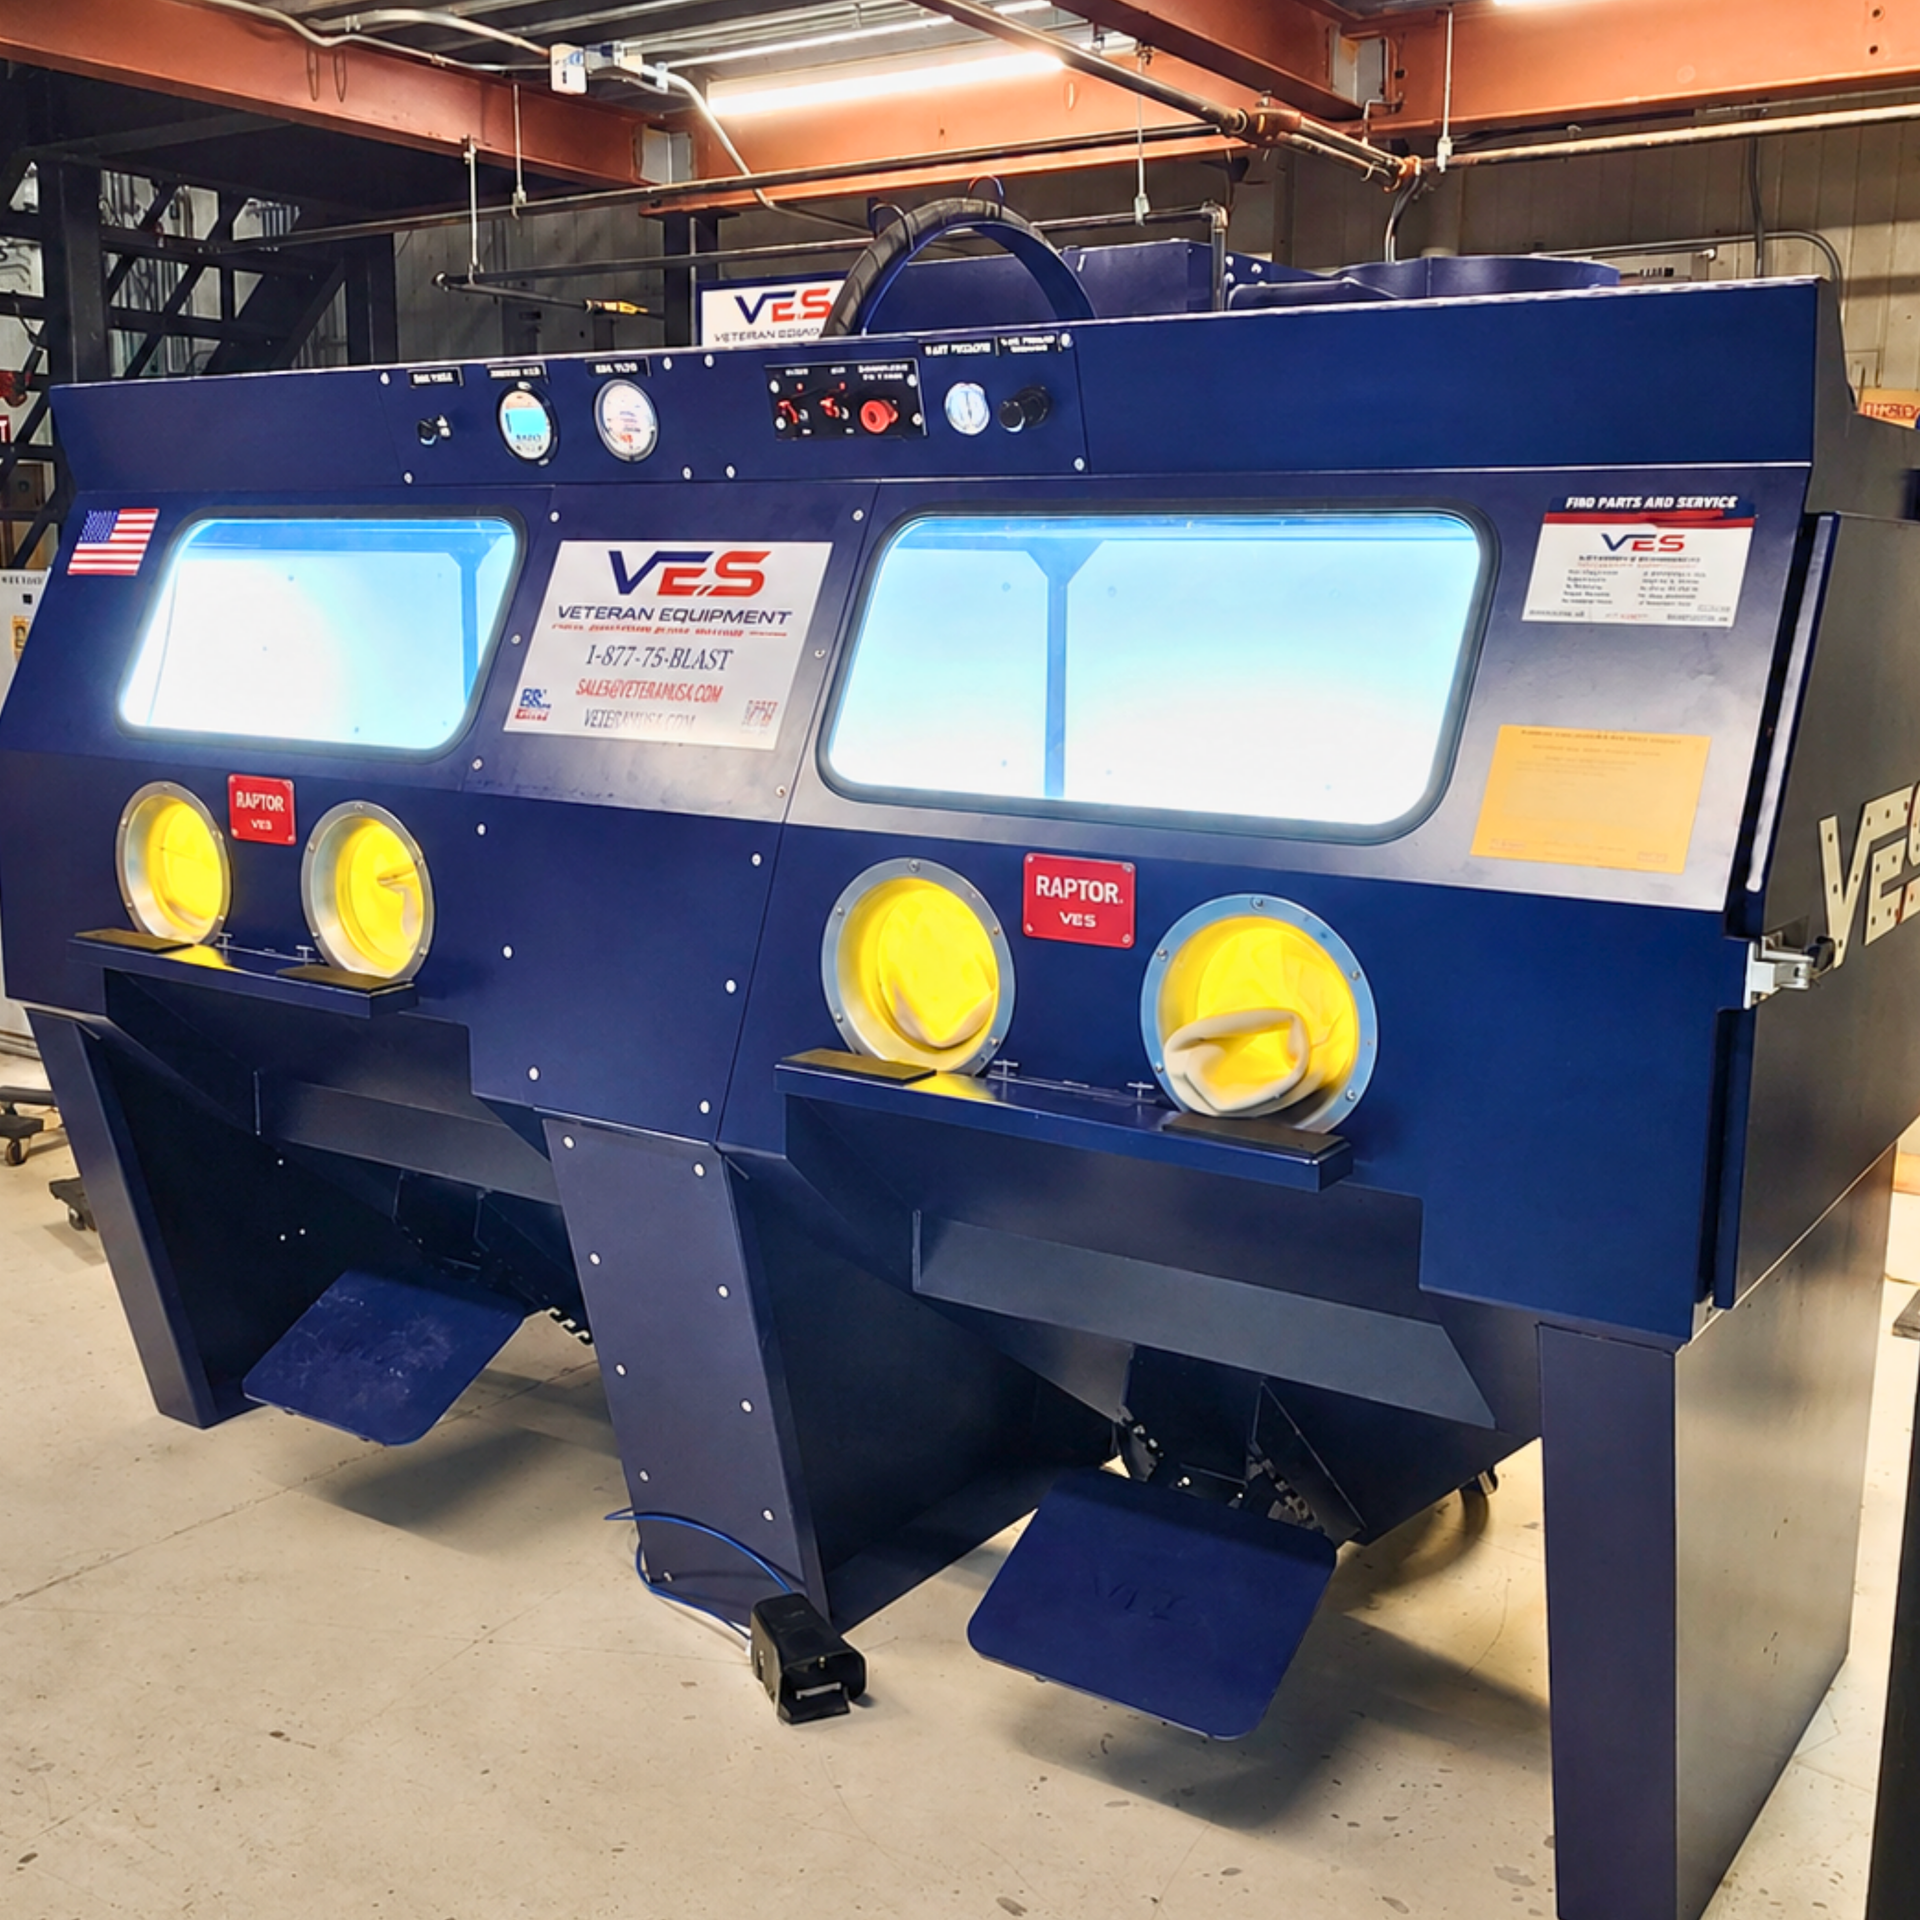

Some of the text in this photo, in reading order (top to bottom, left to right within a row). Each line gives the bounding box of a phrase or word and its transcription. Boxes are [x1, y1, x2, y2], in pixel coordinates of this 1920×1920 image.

[735, 288, 833, 325] VES
[1597, 496, 1642, 508] PARTS
[1676, 495, 1738, 508] SERVICE
[1601, 533, 1685, 552] VES
[608, 550, 772, 597] VES
[557, 605, 793, 625] VETERAN EQUIPMENT
[586, 644, 734, 672] 1-877-75-BLAST
[236, 790, 285, 812] RAPTOR
[1059, 911, 1097, 928] VES
